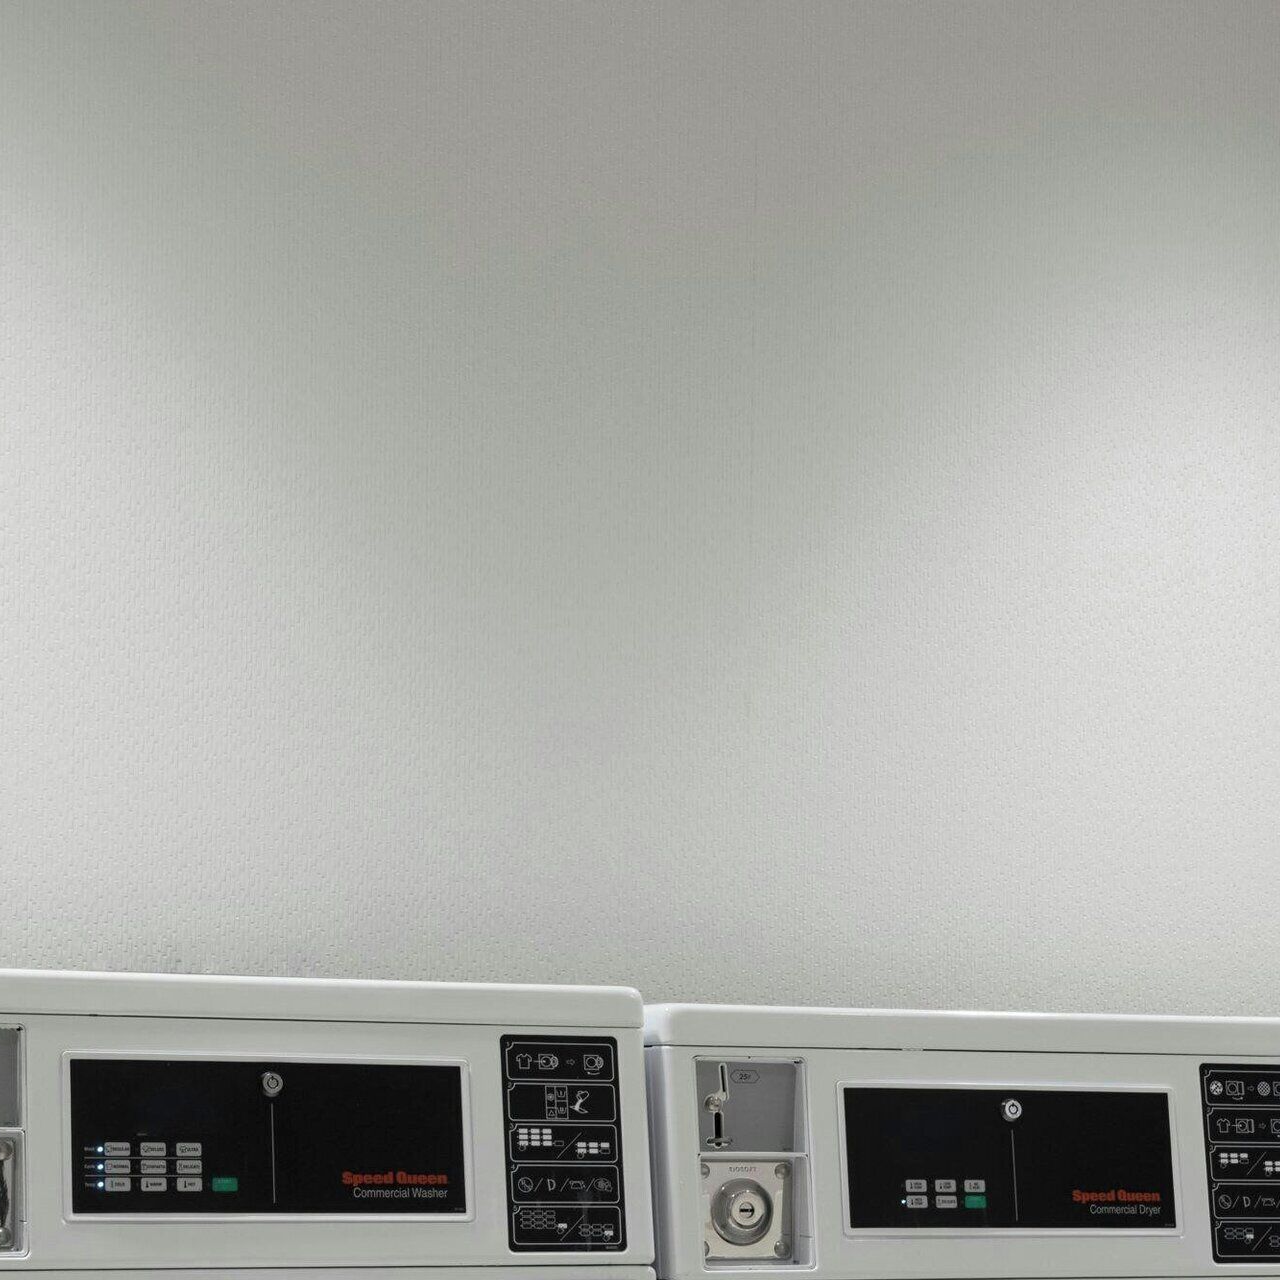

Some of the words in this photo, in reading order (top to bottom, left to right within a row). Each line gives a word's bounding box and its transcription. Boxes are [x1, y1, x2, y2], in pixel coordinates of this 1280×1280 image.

[342, 1171, 394, 1186] Speed
[396, 1171, 448, 1185] Queen
[353, 1187, 410, 1198] Commercial
[411, 1187, 449, 1198] Washer
[1071, 1189, 1116, 1204] Speed
[1117, 1190, 1160, 1201] Queen
[1089, 1204, 1137, 1214] Commercial
[1139, 1204, 1161, 1216] Dryer
